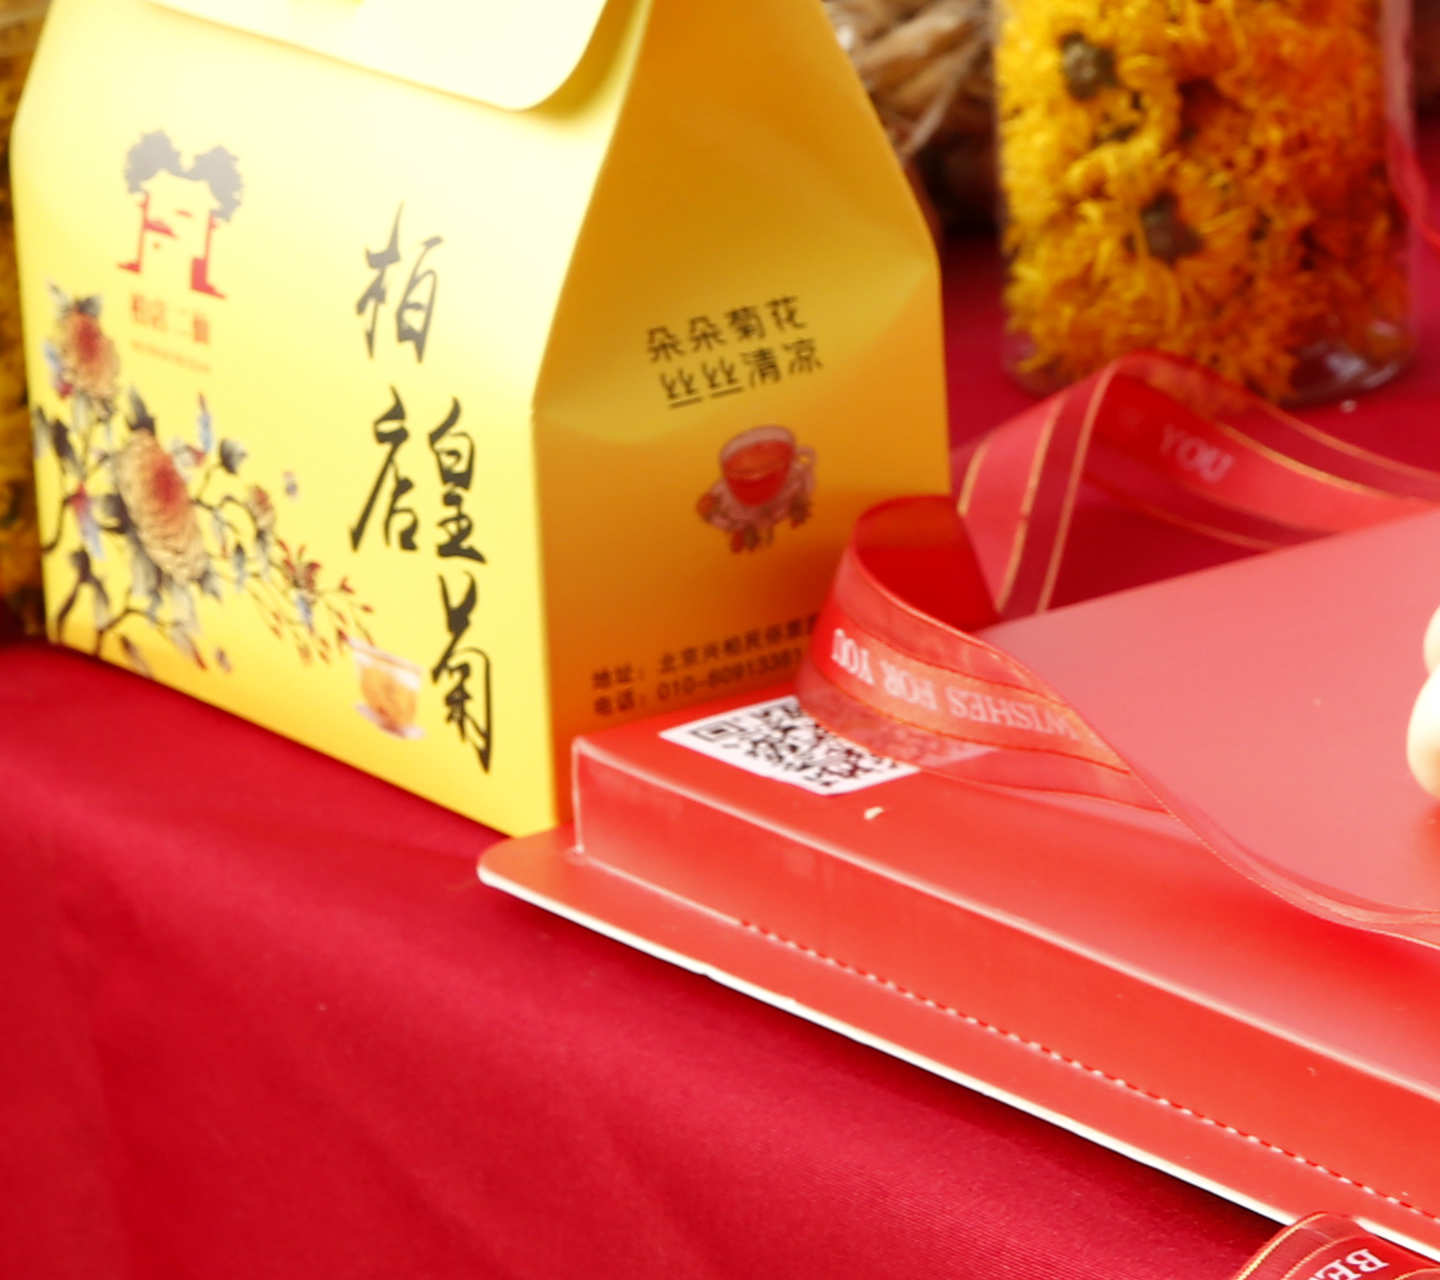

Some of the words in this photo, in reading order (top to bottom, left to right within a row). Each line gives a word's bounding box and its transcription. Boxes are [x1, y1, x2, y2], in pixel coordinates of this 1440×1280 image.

[646, 295, 808, 363] 朵朵菊花
[660, 338, 824, 410] 丝丝清凉
[1162, 423, 1235, 483] YOU
[880, 660, 938, 711] FOR
[946, 686, 1078, 740] WISHES
